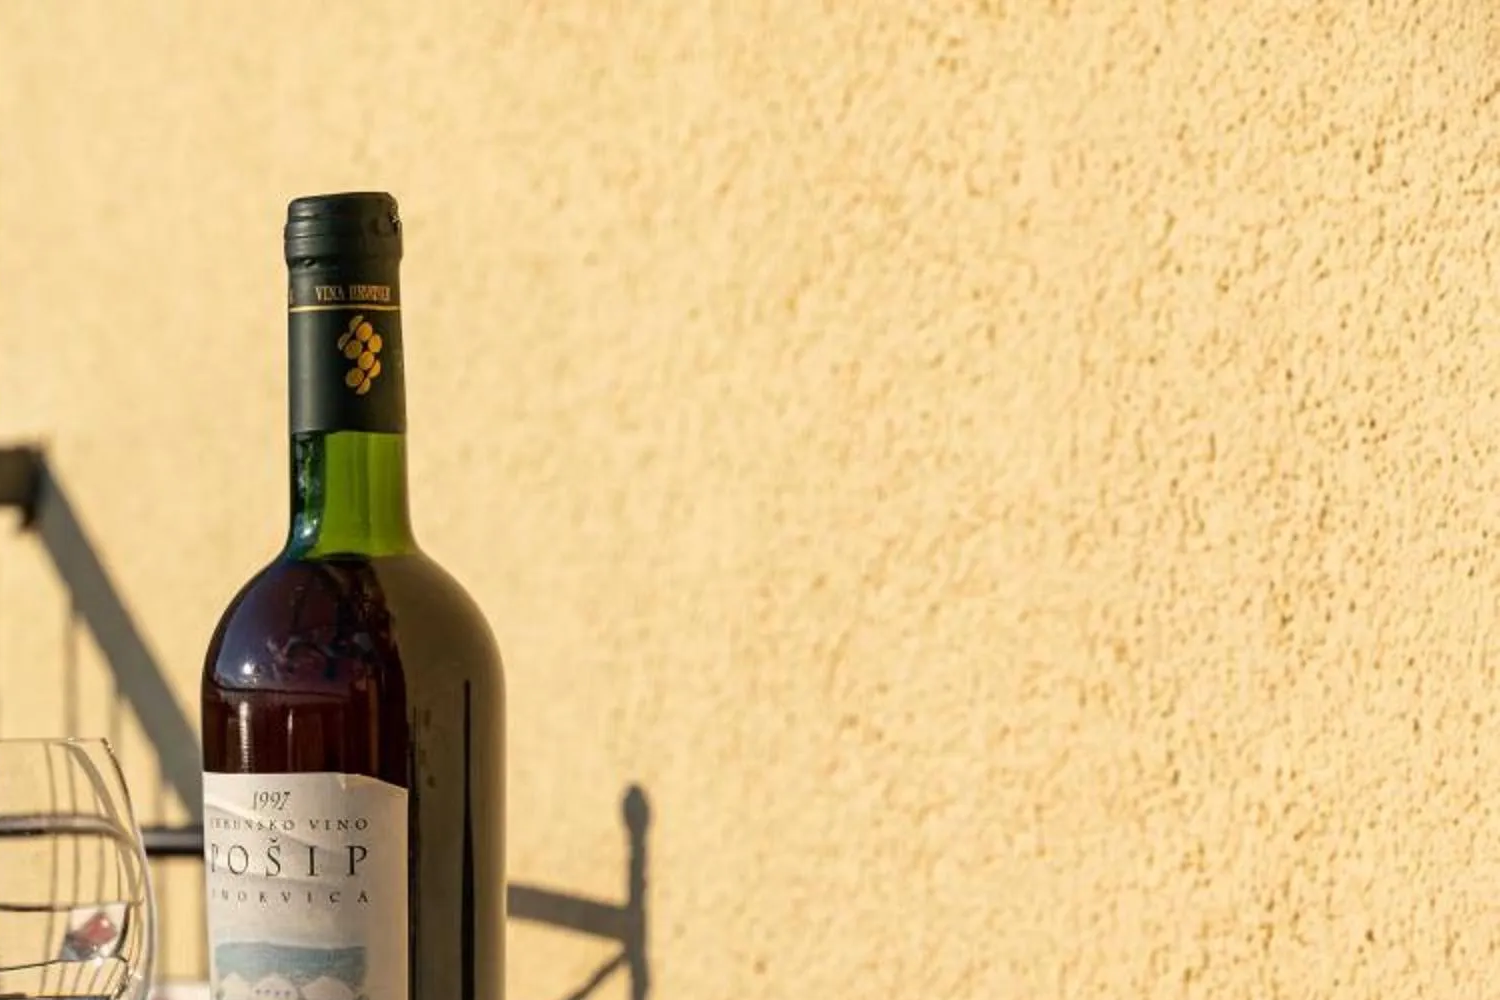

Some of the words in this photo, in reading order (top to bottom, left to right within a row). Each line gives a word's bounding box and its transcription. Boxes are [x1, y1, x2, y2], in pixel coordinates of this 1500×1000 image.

[252, 791, 292, 811] 1997
[308, 817, 369, 831] VINO
[211, 836, 368, 877] POŠIP
